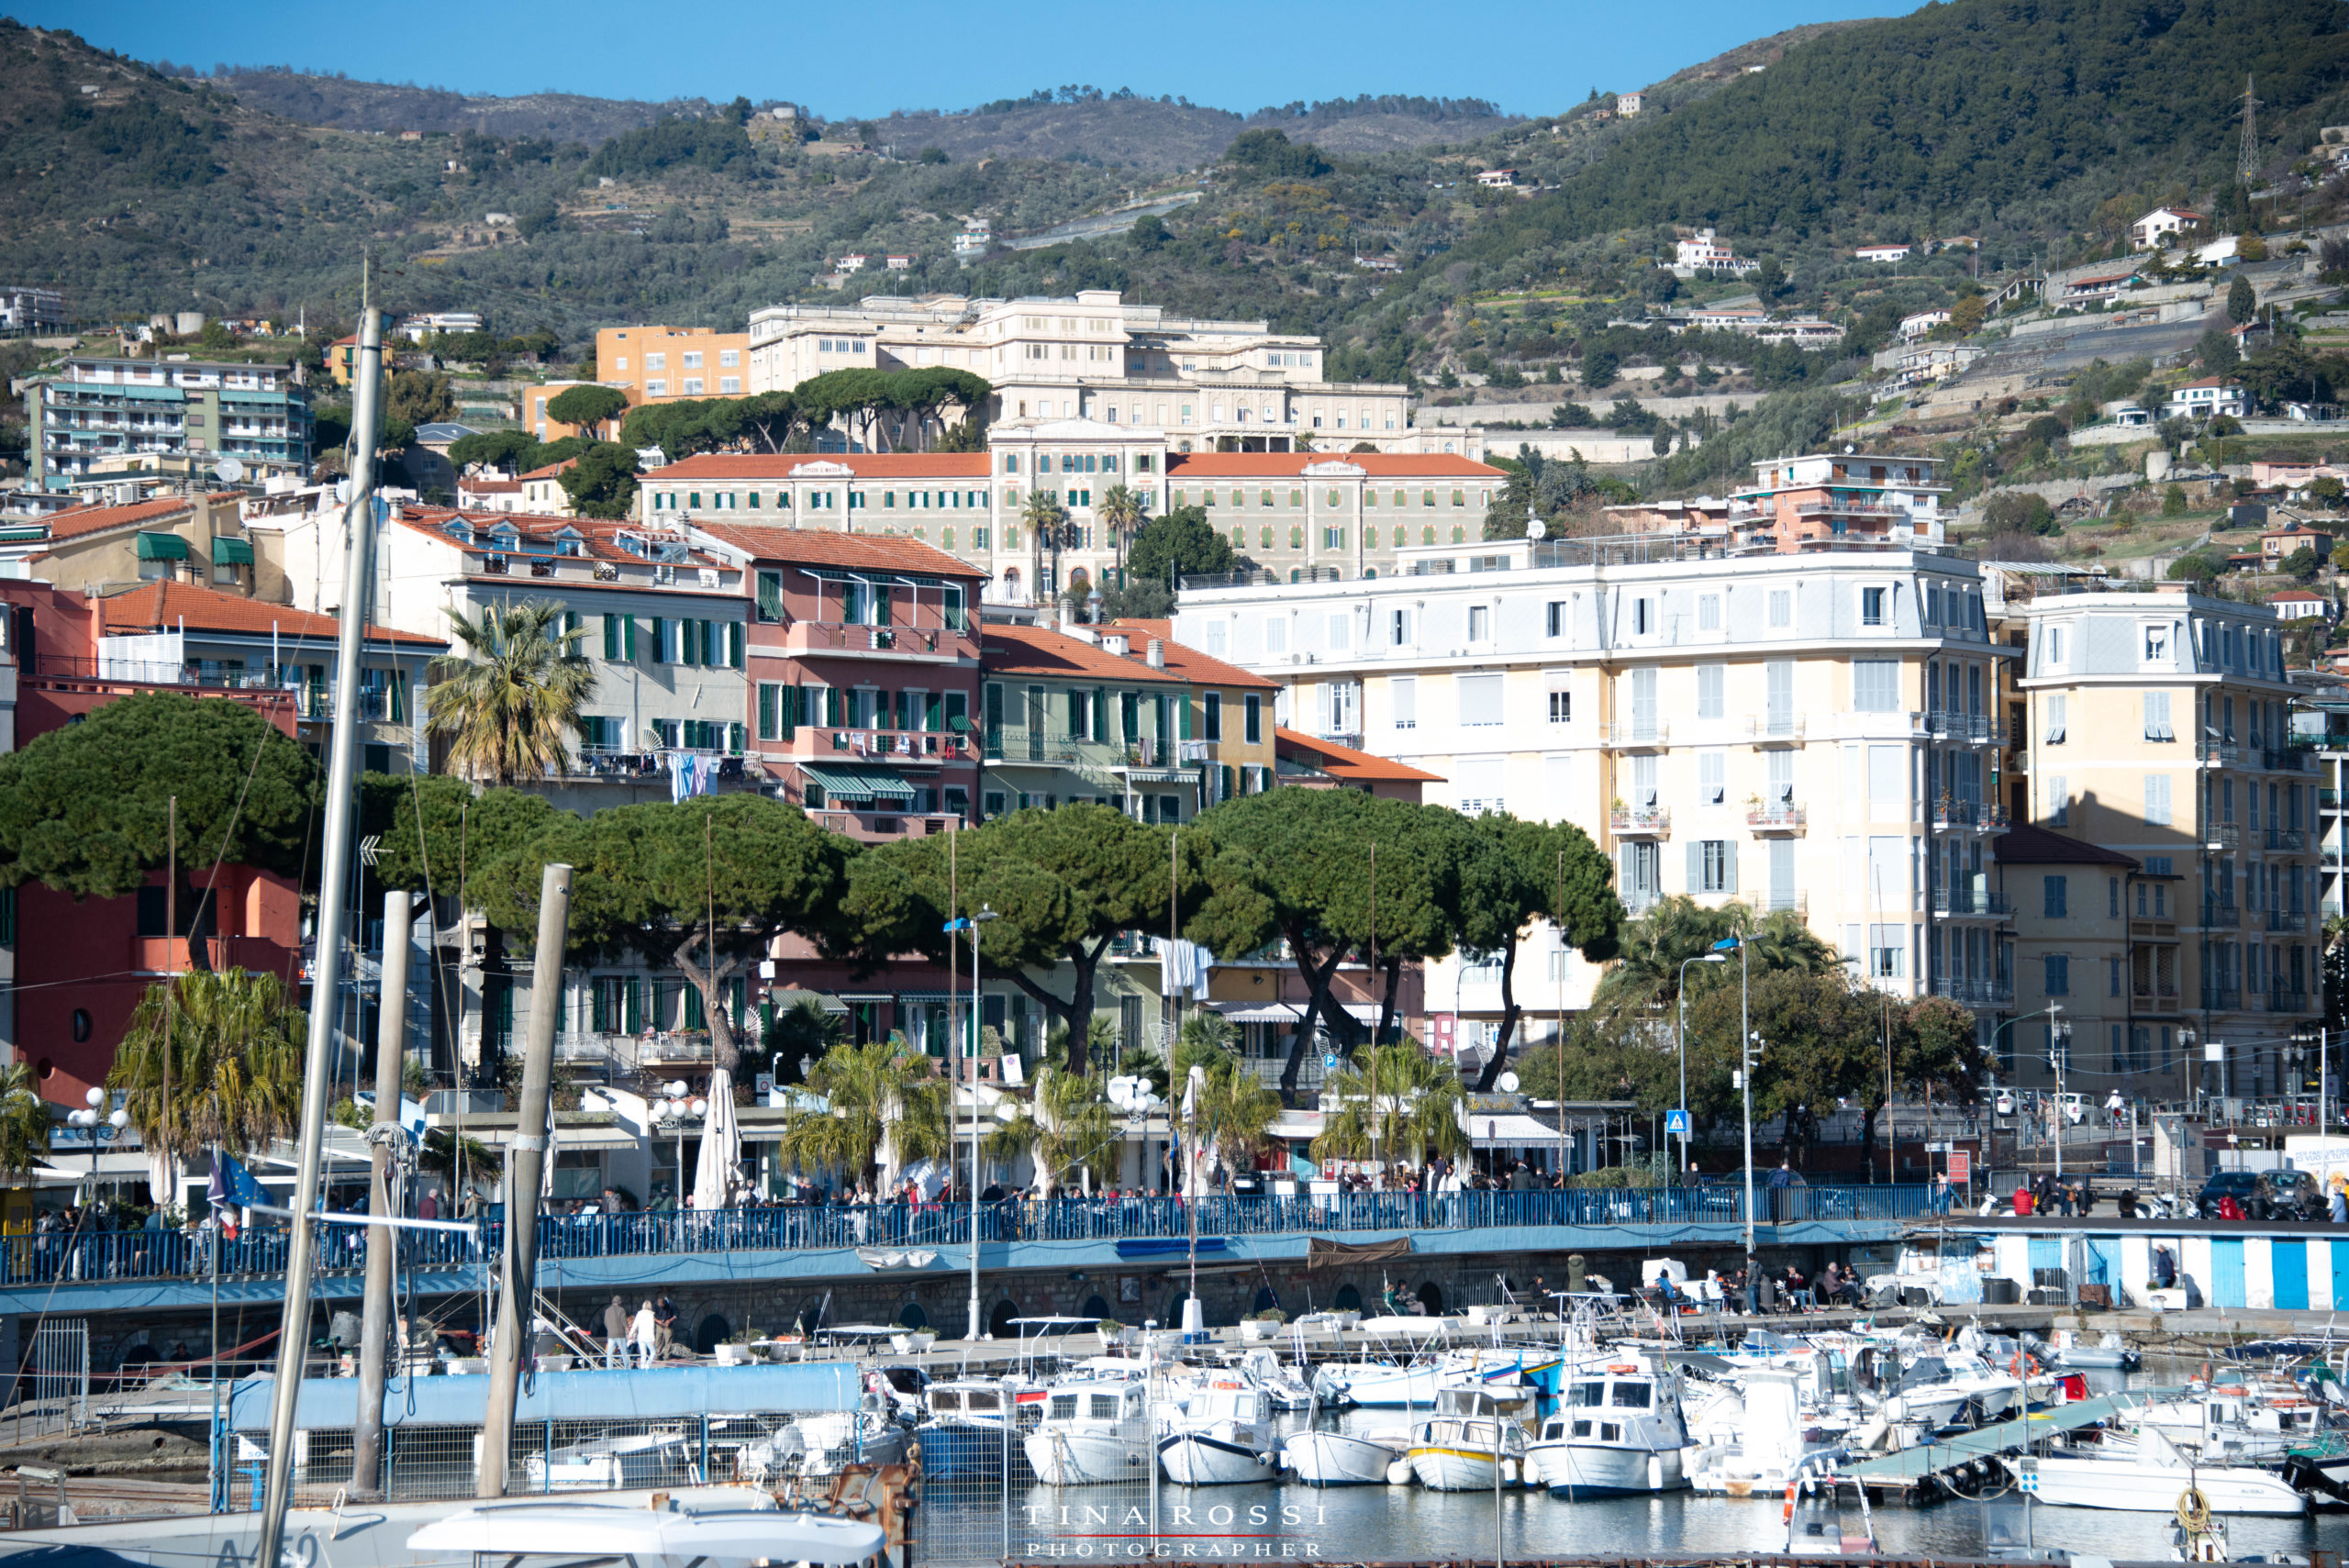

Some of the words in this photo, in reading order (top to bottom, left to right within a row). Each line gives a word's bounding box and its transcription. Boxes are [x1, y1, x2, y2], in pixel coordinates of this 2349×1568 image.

[1433, 1012, 1458, 1056] R
[1327, 1055, 1334, 1065] P
[2305, 1153, 2331, 1162] VUOE
